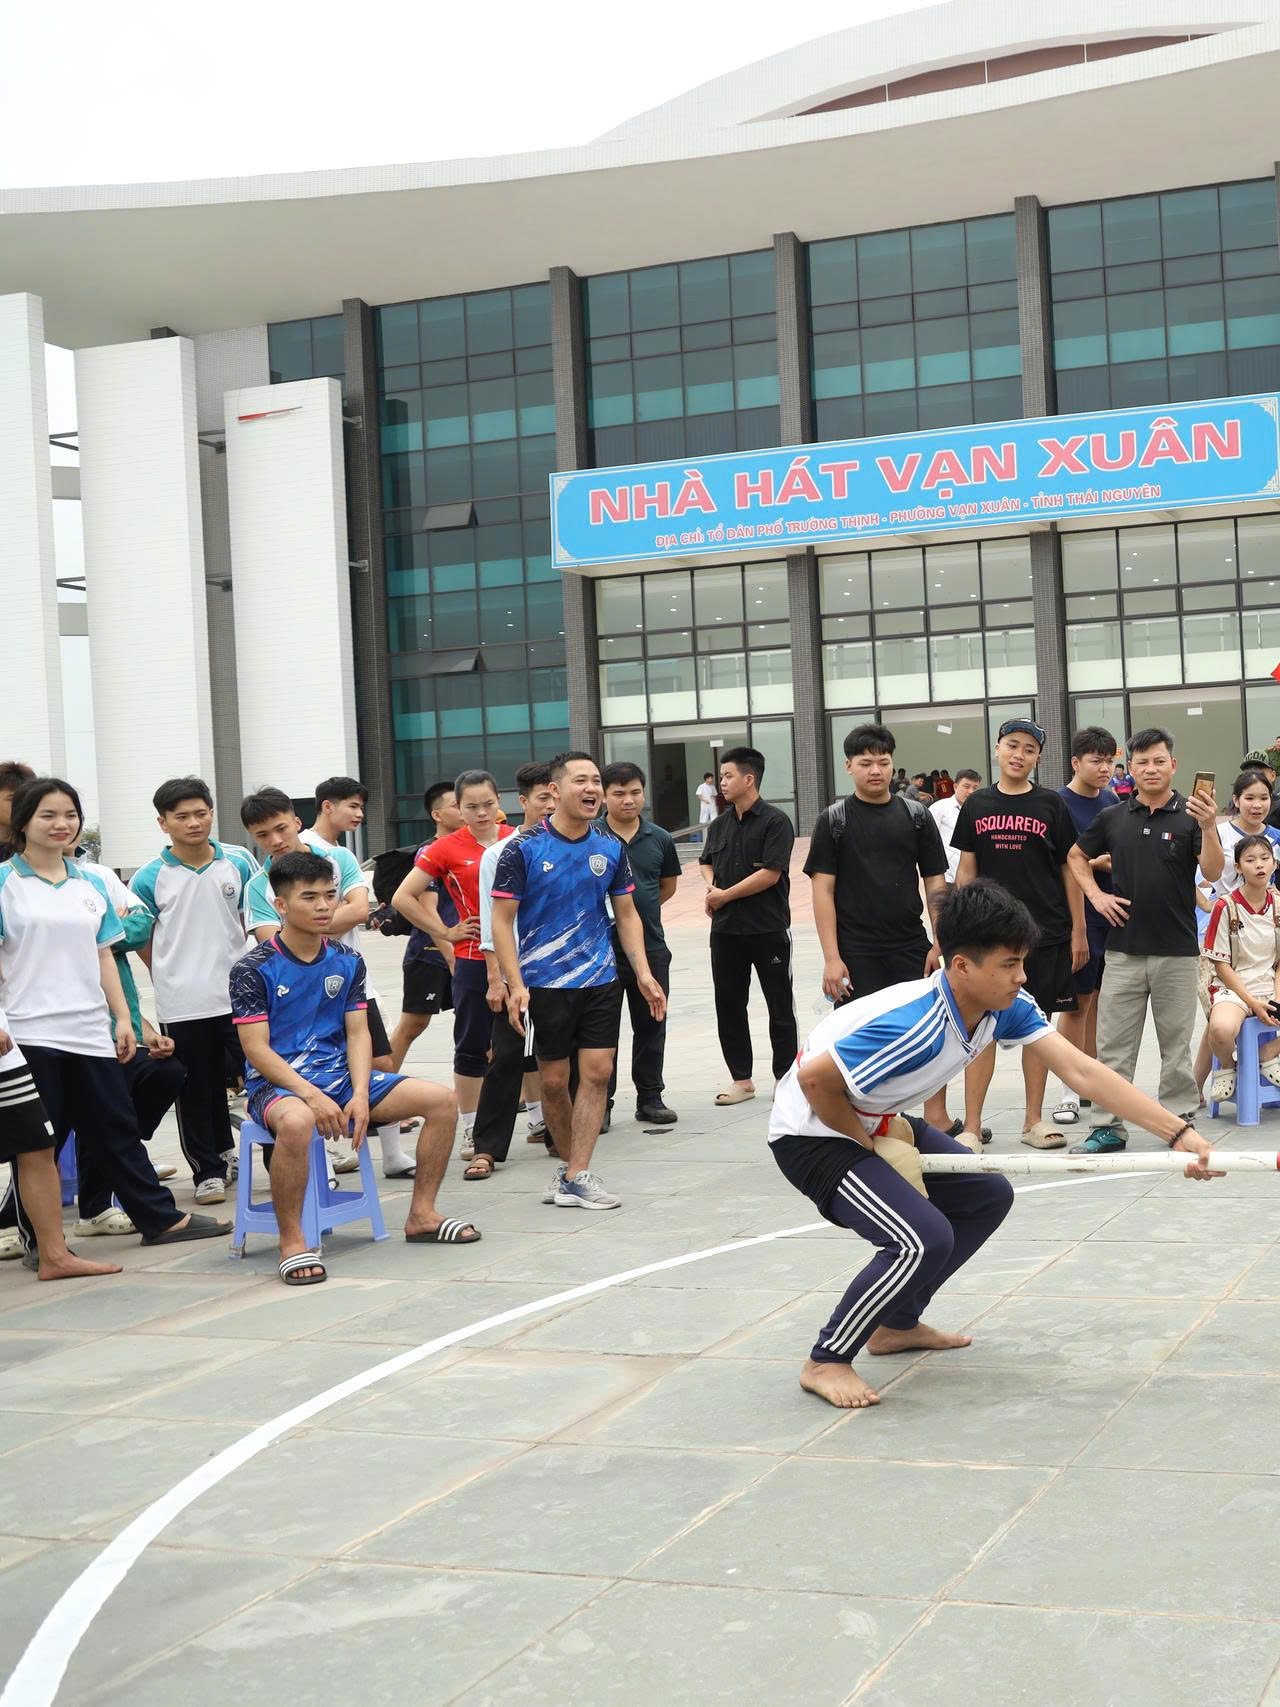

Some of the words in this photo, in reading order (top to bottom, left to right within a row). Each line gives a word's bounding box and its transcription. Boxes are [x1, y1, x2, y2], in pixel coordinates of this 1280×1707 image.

[589, 469, 718, 525] NHÀ
[735, 456, 860, 510] HÁT
[876, 442, 1018, 499] VẠN
[1037, 416, 1241, 478] XUÂN
[727, 525, 754, 539] DÂN
[757, 518, 784, 537] PHỐ
[841, 513, 880, 531] THỊNH
[948, 503, 978, 519] VẠN
[981, 497, 1020, 514] XUÂN
[1067, 488, 1099, 505] THÁI
[1102, 483, 1161, 502] NGUYÊN
[975, 815, 1047, 839] DSQUARED2
